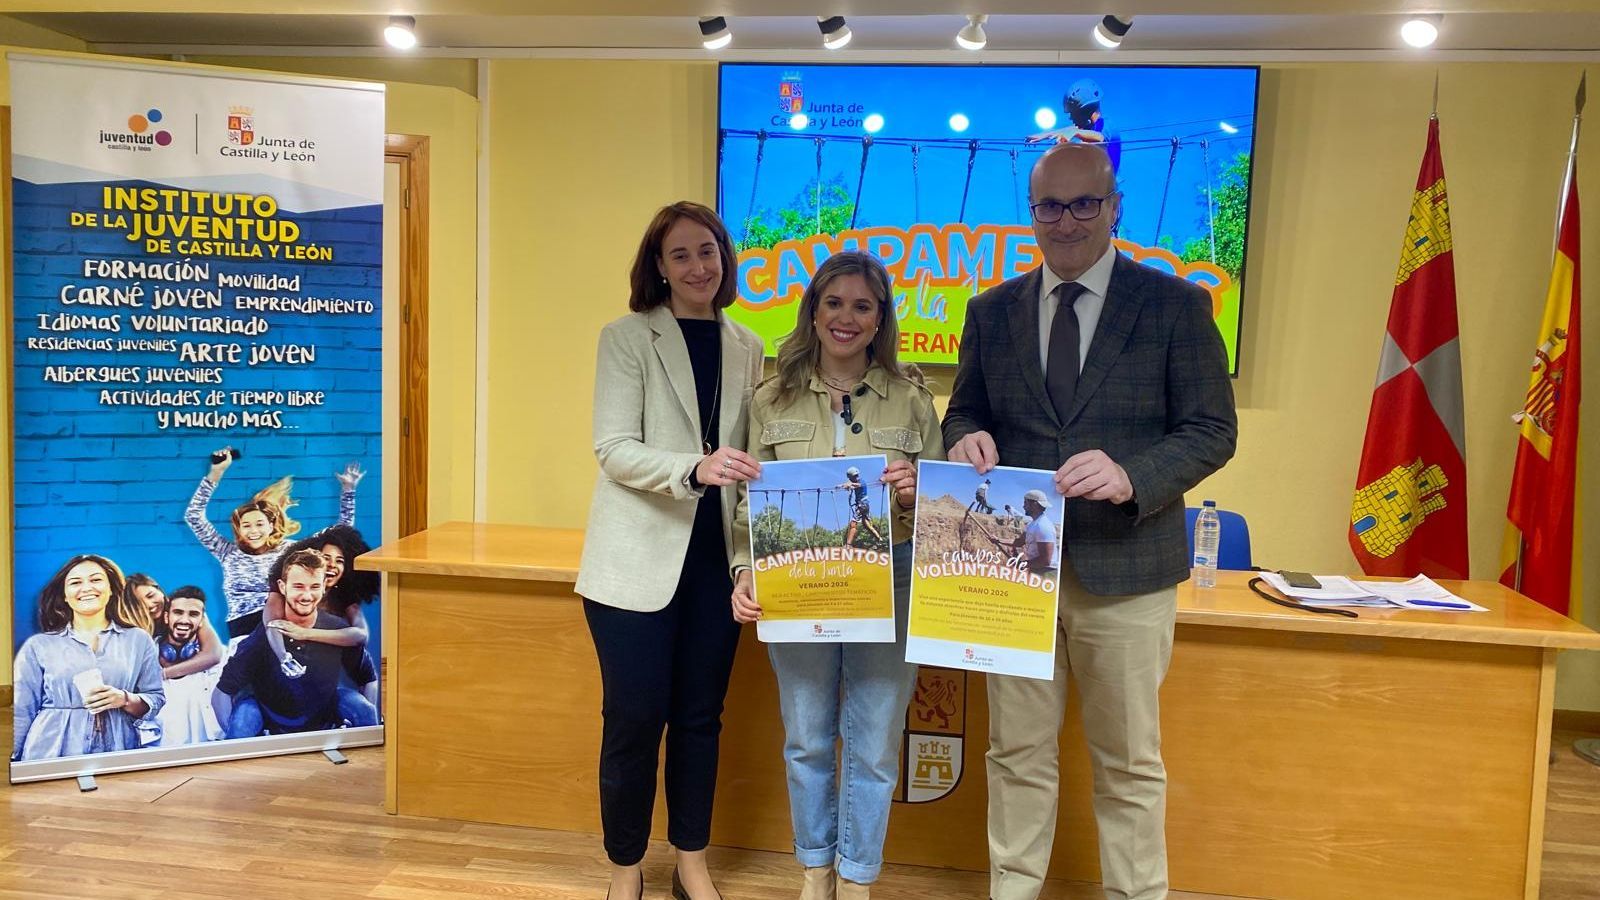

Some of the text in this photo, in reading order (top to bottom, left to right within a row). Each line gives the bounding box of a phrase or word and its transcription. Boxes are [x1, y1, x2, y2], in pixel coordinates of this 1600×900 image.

[807, 102, 864, 113] Junta de
[820, 118, 828, 129] y
[832, 116, 863, 127] León
[100, 130, 154, 144] juventud
[257, 135, 315, 149] Junta de
[220, 146, 316, 162] Castilla y León
[103, 186, 278, 218] INSTITUTO
[71, 212, 300, 243] DE LA JUVENTUD
[146, 240, 332, 261] DE CASTILLA Y LEÓN
[897, 332, 960, 354] ERAN
[755, 547, 890, 572] CAMPAMENTOS
[789, 558, 855, 579] de la Junta
[942, 548, 1030, 572] campos de
[799, 582, 830, 590] VERANO
[916, 562, 1056, 593] VOLUNTARIADO
[958, 585, 1009, 597] VERANO 2026
